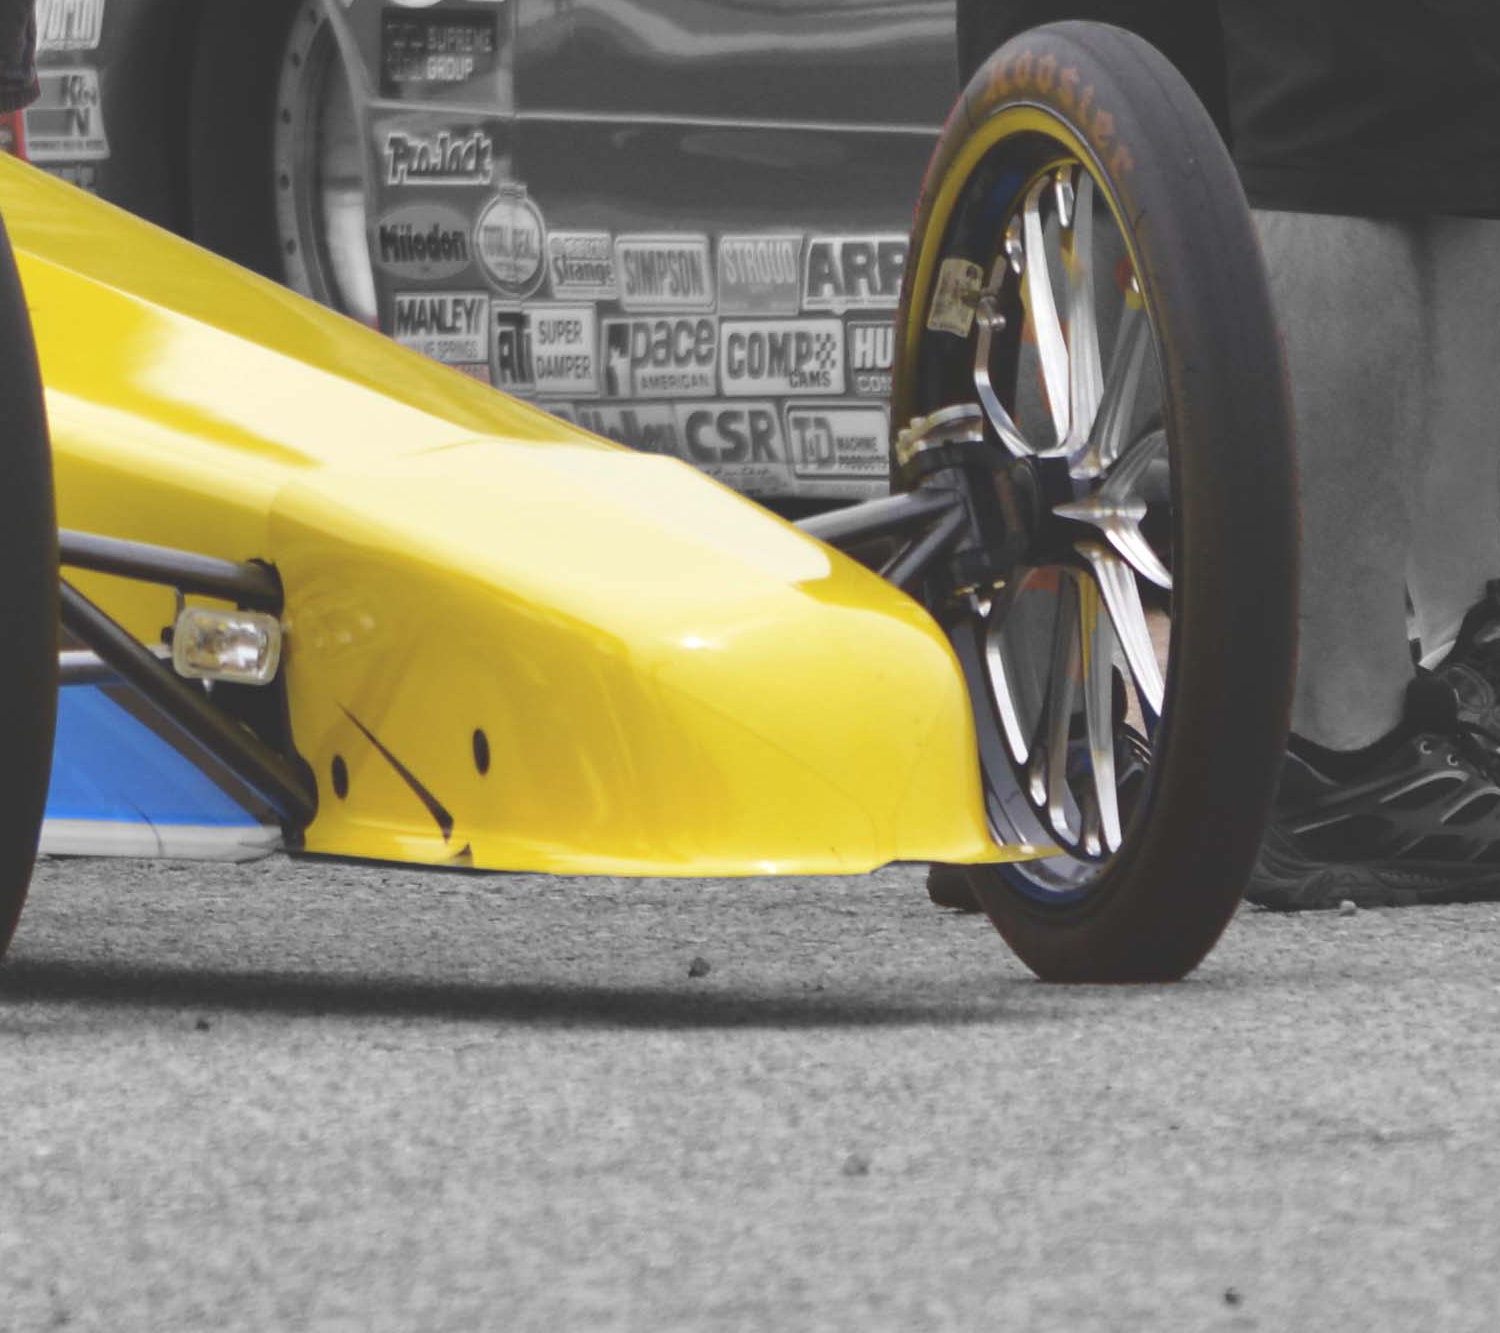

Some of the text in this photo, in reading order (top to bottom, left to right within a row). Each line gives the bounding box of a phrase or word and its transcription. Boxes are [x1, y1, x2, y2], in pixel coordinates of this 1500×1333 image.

[427, 55, 474, 81] GROUP
[379, 222, 469, 263] Milodon
[623, 248, 706, 297] SIMPSON
[721, 239, 797, 284] STROUD
[393, 297, 477, 335] MANLEY
[538, 320, 582, 344] SUPER
[535, 356, 593, 380] DAMPER
[726, 331, 813, 380] COMP
[640, 373, 710, 390] AMERICAN
[789, 370, 832, 388] CAMS
[685, 409, 781, 463] CSR
[836, 436, 877, 451] MACHINE
